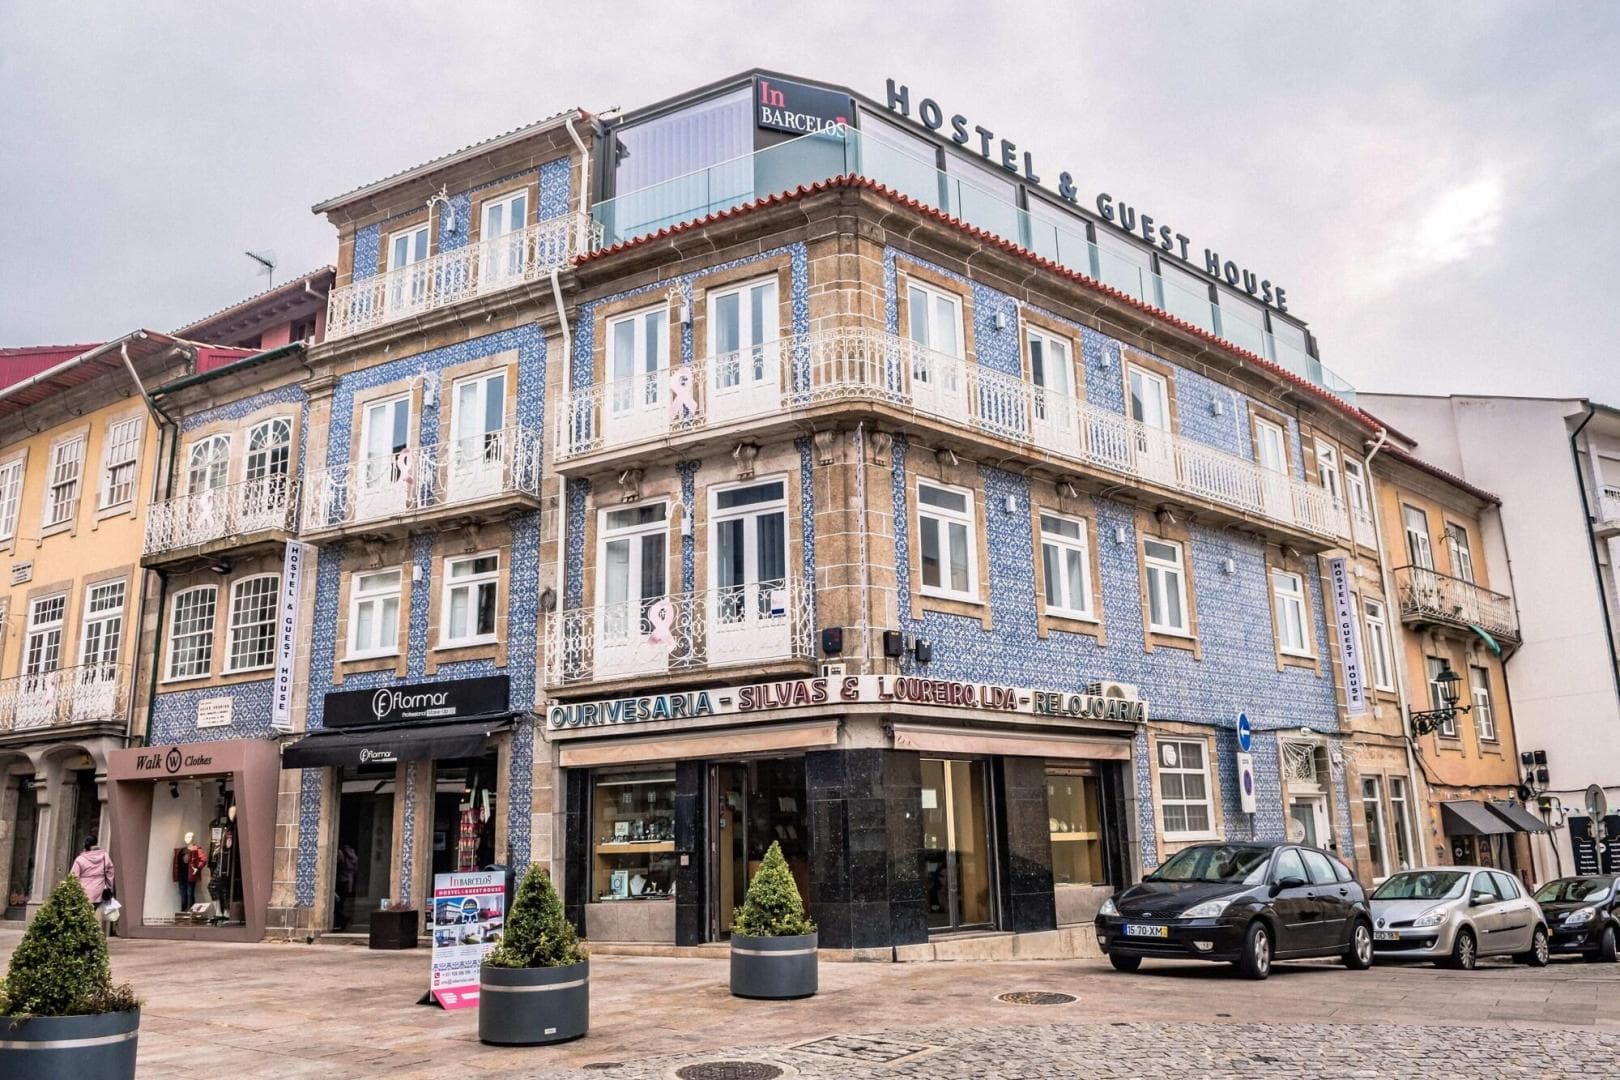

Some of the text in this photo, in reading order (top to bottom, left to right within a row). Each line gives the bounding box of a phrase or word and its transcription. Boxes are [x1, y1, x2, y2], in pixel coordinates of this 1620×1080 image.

[761, 80, 785, 108] In
[761, 106, 847, 138] BARCELOS
[885, 78, 1288, 312] HOSTEL & GUEST HOUSE
[289, 547, 299, 596] HOSTEL
[284, 617, 293, 659] GUEST
[1334, 563, 1345, 605] HOSTEL
[1342, 622, 1352, 658] GUEST
[1348, 665, 1359, 702] HOUSE
[279, 667, 289, 710] HOUSE
[393, 691, 449, 710] flormar
[550, 691, 713, 729] OURIVESARIA
[738, 679, 828, 711] SILVAS
[1033, 691, 1147, 721] RELOJOARIA
[136, 754, 162, 770] Walk
[184, 755, 213, 767] Clothes
